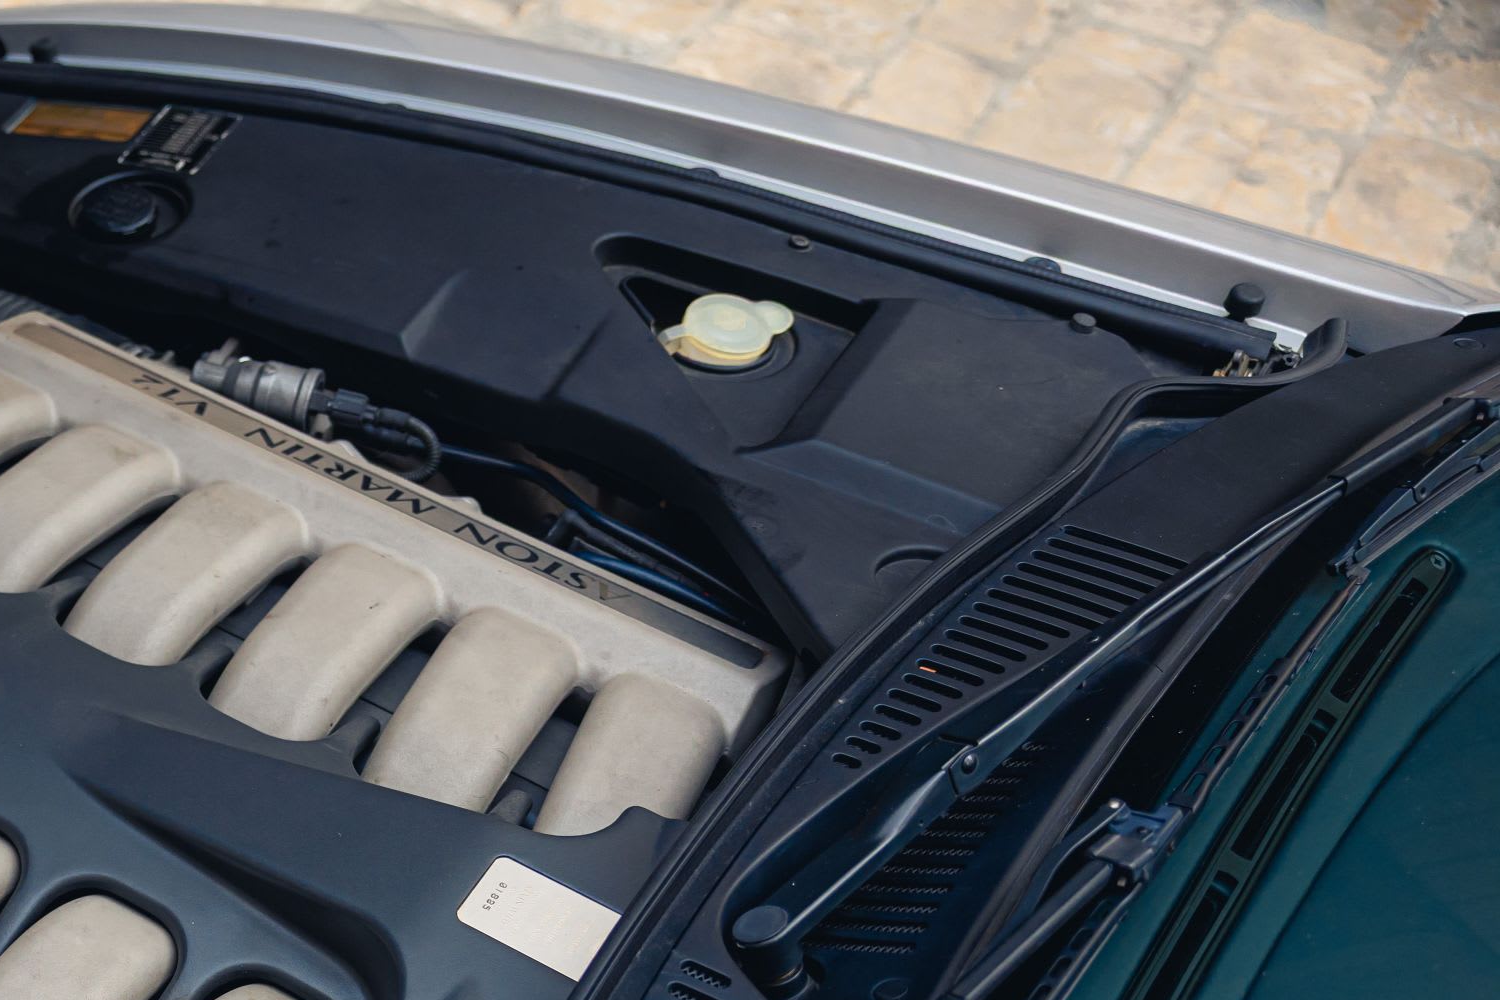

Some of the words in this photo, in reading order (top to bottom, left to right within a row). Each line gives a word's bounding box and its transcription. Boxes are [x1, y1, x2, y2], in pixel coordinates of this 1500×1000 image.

[132, 373, 207, 416] V12
[243, 427, 436, 515] MARTIN
[453, 522, 632, 601] ASTON
